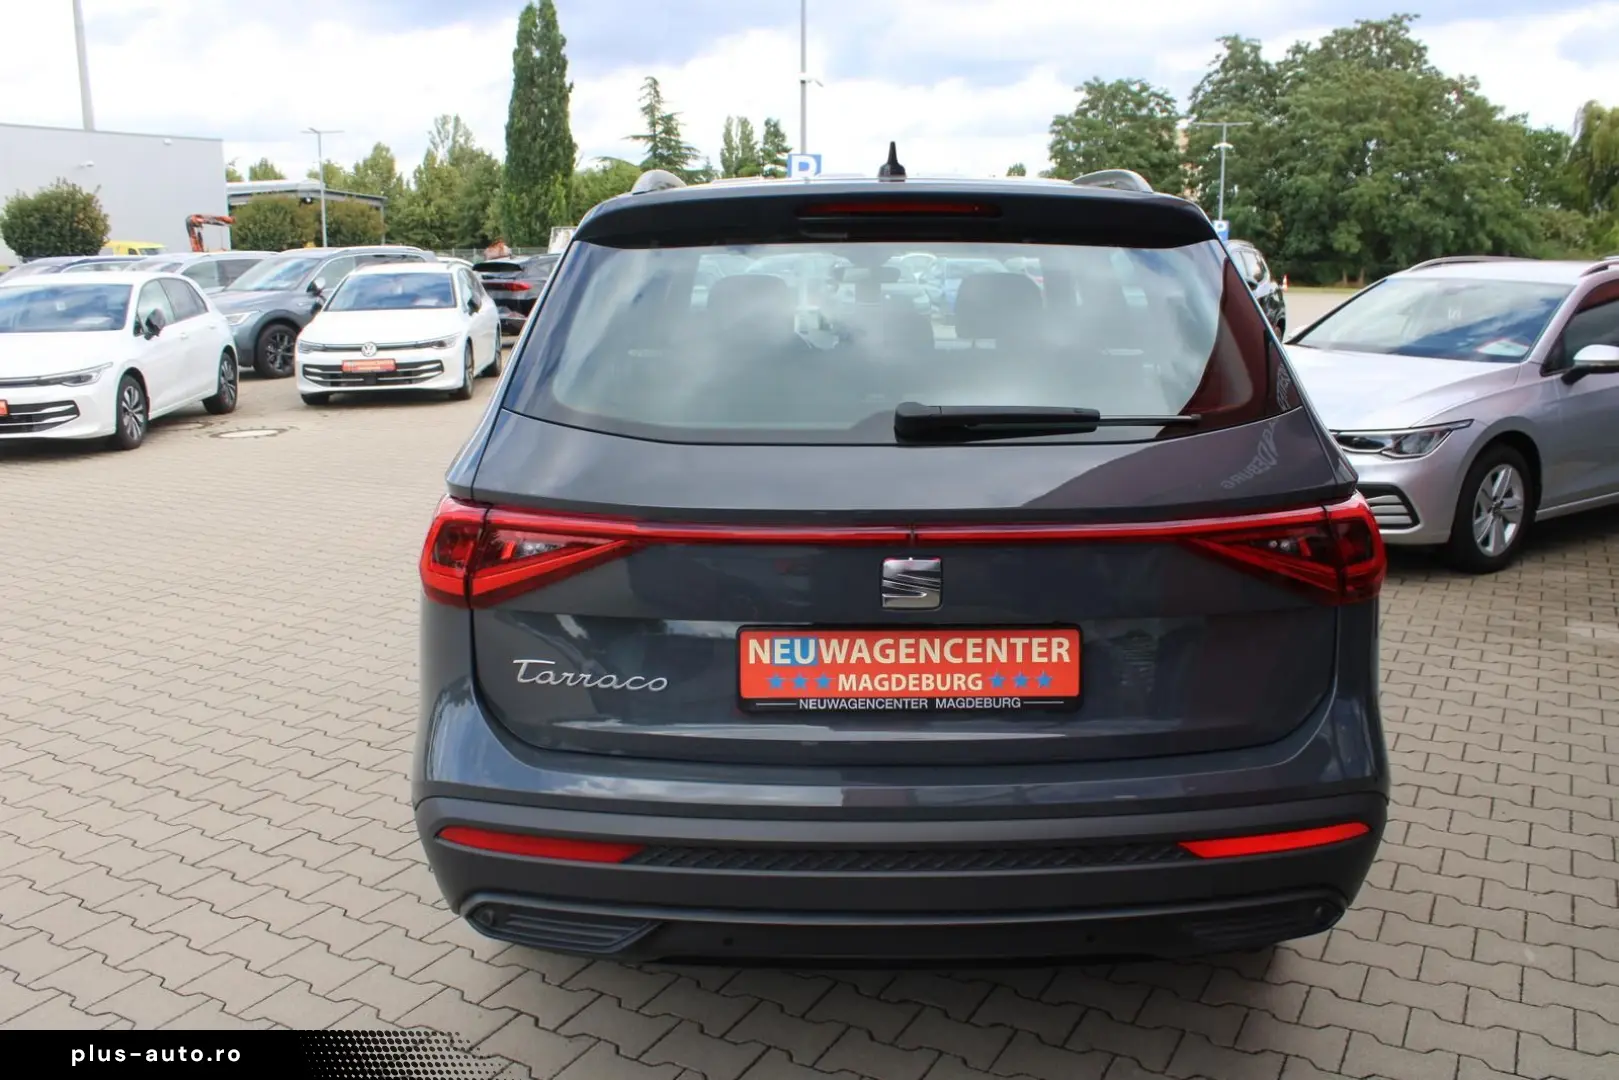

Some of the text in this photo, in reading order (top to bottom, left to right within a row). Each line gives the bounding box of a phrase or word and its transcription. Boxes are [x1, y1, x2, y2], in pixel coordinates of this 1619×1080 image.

[791, 155, 817, 181] P
[748, 636, 1071, 665] NEUWAGENCENTER
[512, 658, 669, 693] Tarraco
[837, 672, 984, 692] MAGDEBURG
[798, 696, 1022, 710] NEUWAGENCENTER MAGDEBURG
